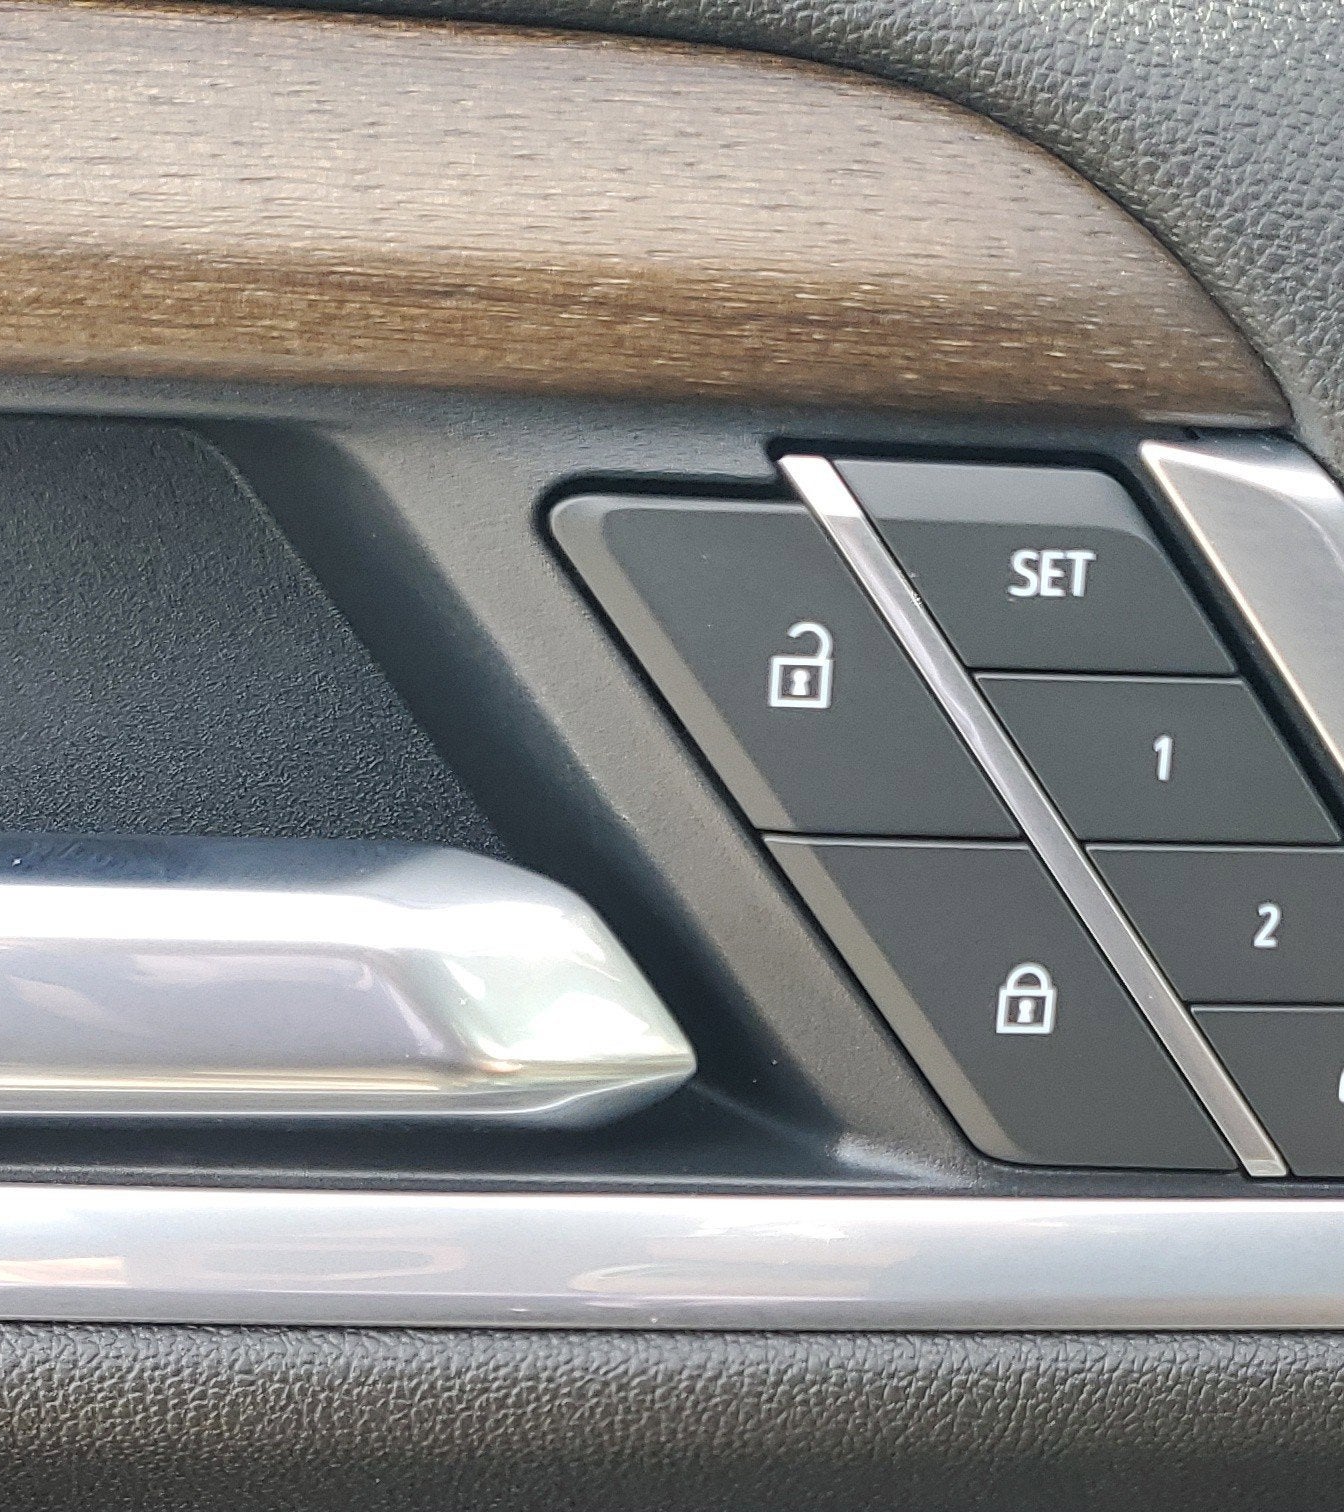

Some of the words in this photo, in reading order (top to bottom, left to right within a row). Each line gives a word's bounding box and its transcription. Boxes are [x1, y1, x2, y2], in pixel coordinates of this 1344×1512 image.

[1007, 548, 1096, 599] SET
[1152, 733, 1175, 782] 1
[1252, 900, 1283, 950] 2
